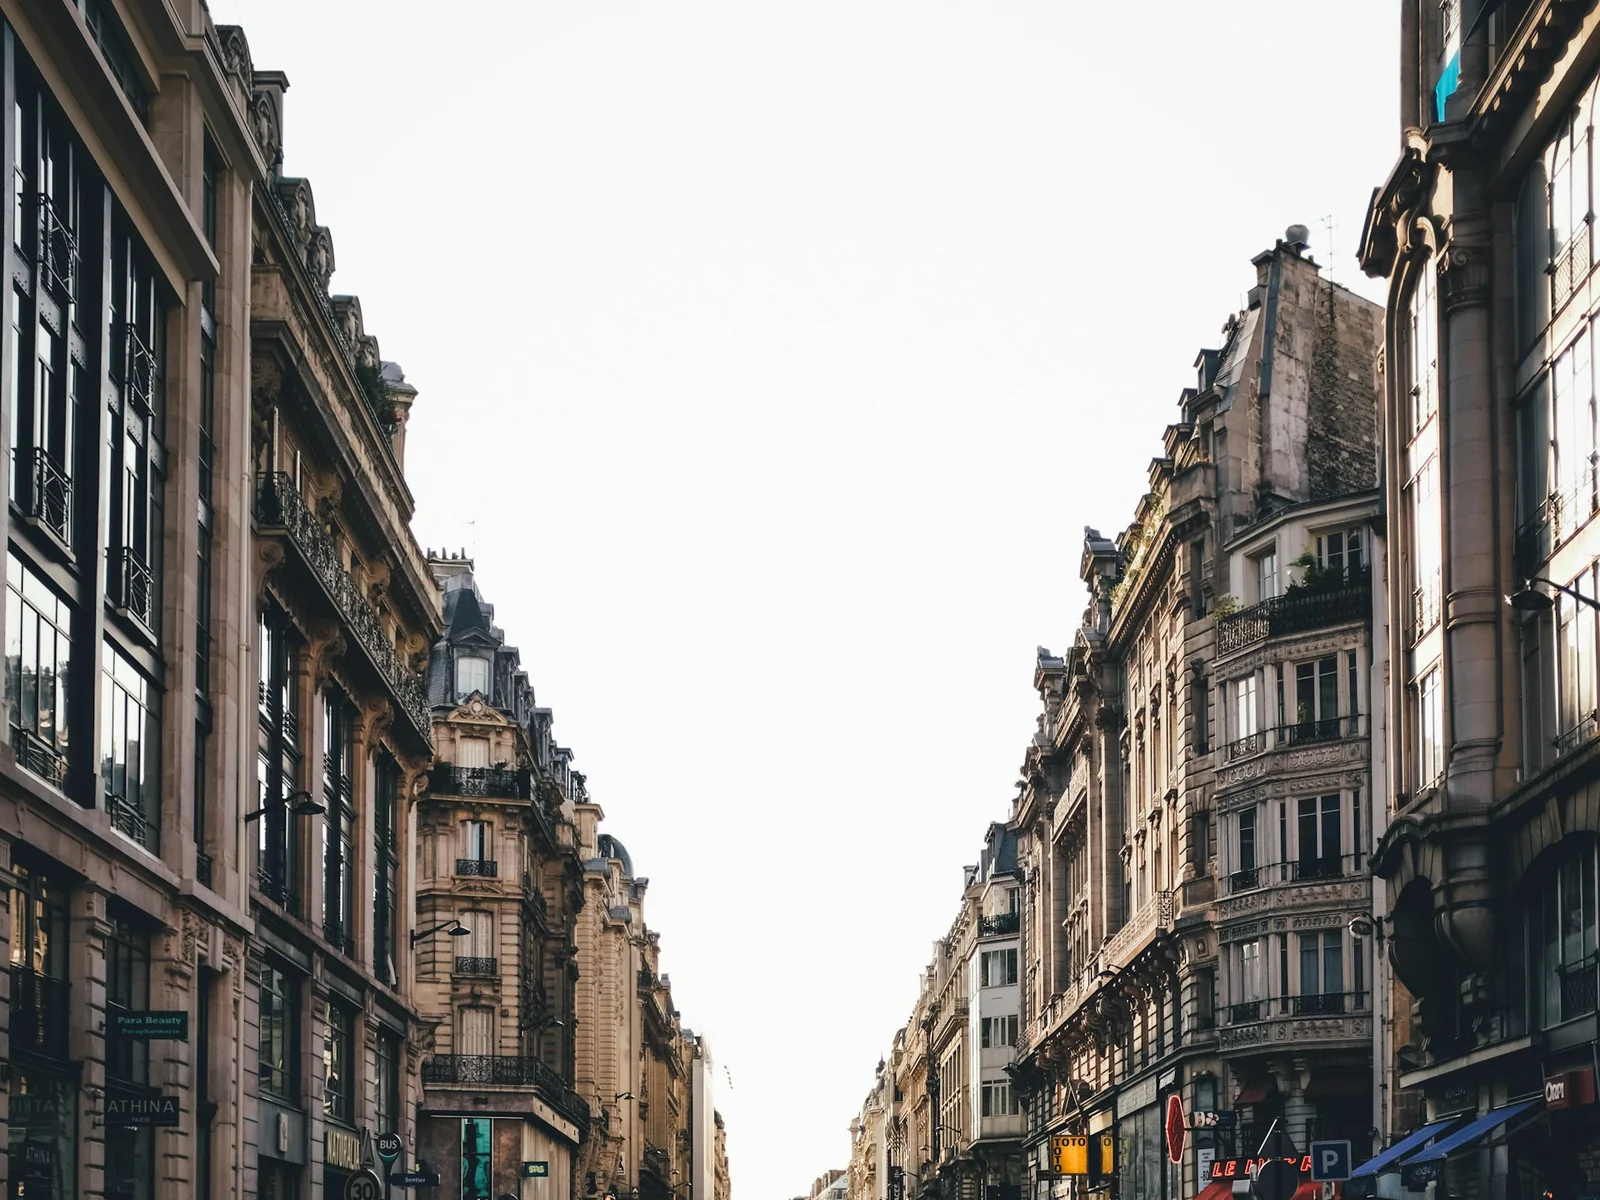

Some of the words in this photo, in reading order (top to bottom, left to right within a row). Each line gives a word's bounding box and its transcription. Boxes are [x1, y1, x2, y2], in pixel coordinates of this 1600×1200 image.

[118, 1016, 142, 1024] Para
[146, 1016, 182, 1025] Beauty
[108, 1100, 175, 1113] ATHINA
[380, 1140, 397, 1149] BUS
[1054, 1138, 1085, 1146] TOTO
[25, 1146, 51, 1165] ATHINA
[327, 1129, 361, 1171] NATURALIA
[1212, 1160, 1237, 1178] LE
[1322, 1150, 1339, 1174] P
